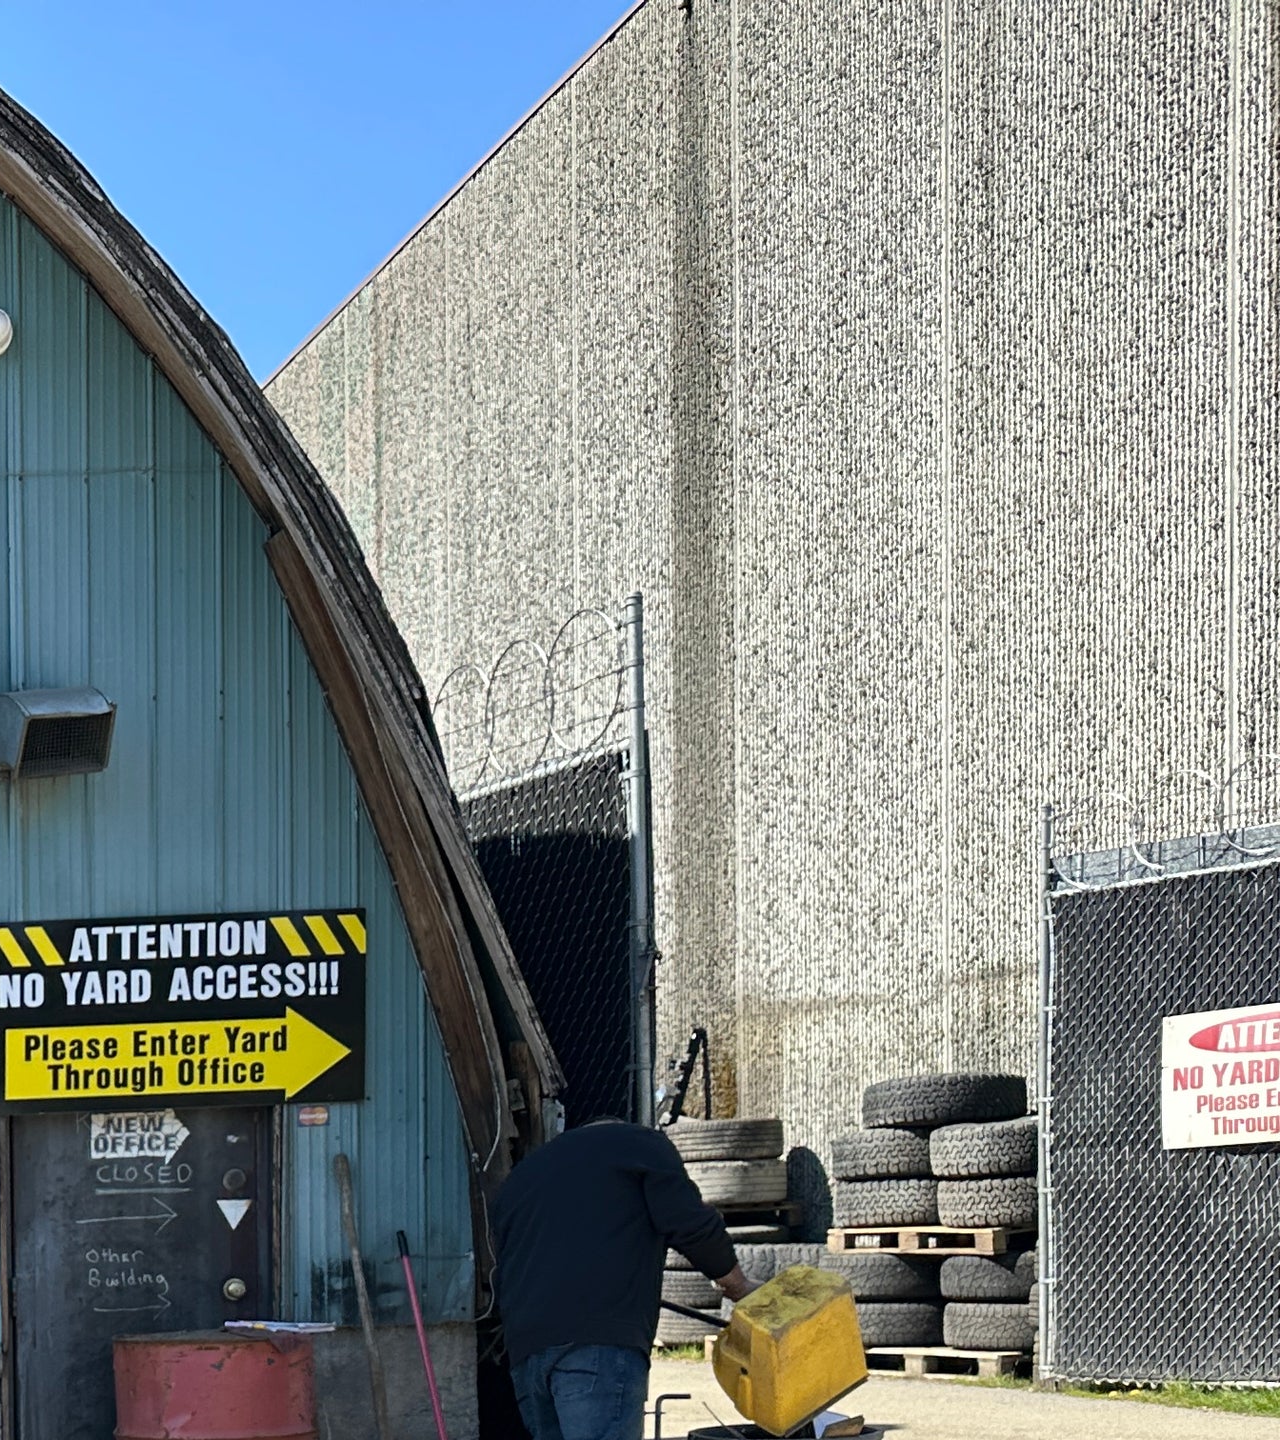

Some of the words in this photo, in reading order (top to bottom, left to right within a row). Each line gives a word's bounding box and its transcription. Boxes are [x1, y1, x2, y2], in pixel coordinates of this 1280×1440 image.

[69, 920, 267, 963] ATTENTION
[60, 968, 152, 1006] YARD
[168, 961, 340, 1001] ACCESS!!!
[24, 1034, 118, 1062] Please
[133, 1030, 210, 1058] Enter
[224, 1025, 288, 1054] Yard
[47, 1061, 163, 1093] Through
[178, 1057, 265, 1085] Office
[1173, 1066, 1204, 1092] NO
[1212, 1058, 1280, 1088] YARD
[1196, 1092, 1260, 1114] Please
[105, 1116, 163, 1134] NEW
[94, 1134, 178, 1153] OFFICE
[96, 1163, 192, 1184] CLOSED
[86, 1248, 144, 1263] Other
[88, 1268, 169, 1296] Building
